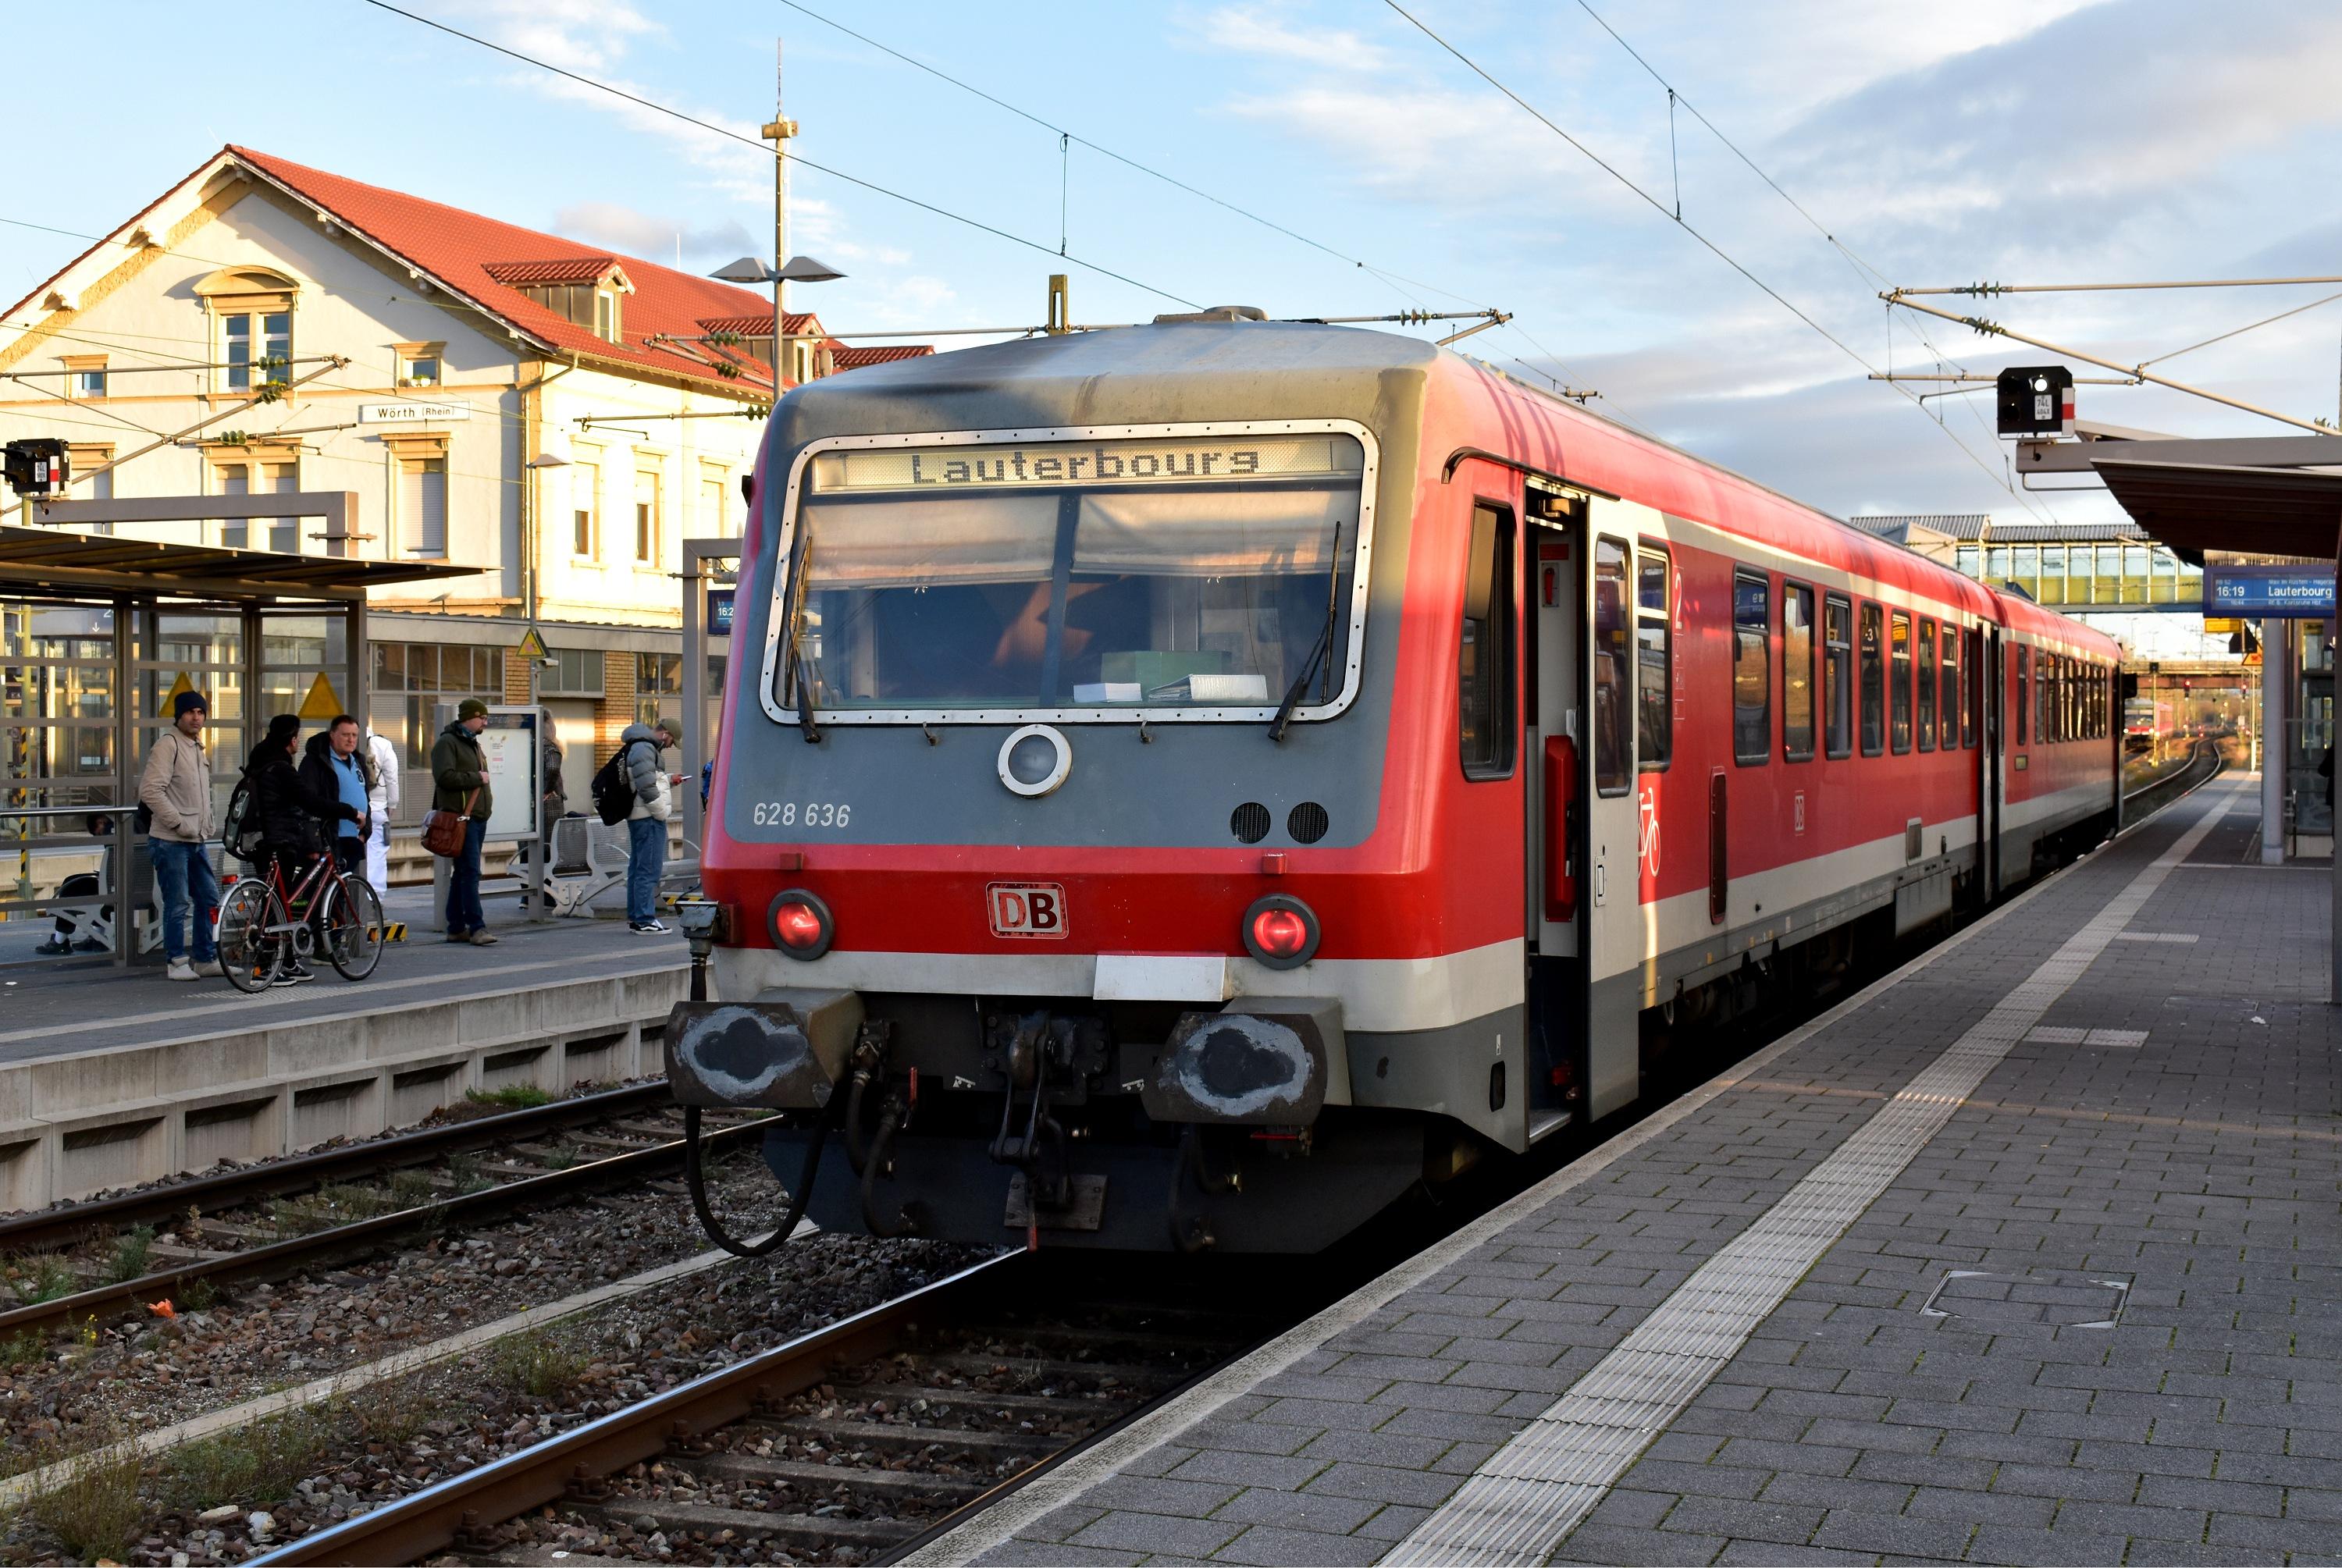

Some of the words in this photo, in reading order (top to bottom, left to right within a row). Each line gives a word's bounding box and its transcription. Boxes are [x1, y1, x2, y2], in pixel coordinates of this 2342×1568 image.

[378, 407, 415, 418] Wörth
[422, 407, 454, 416] (Rhein)
[912, 448, 1259, 484] Lauterbourg
[1675, 572, 1682, 629] 2
[2216, 586, 2245, 596] 16:19
[2268, 586, 2332, 599] Lauterbourg
[717, 607, 734, 617] 16:2
[753, 802, 796, 826] 628
[805, 803, 851, 827] 636
[998, 891, 1058, 929] DB
